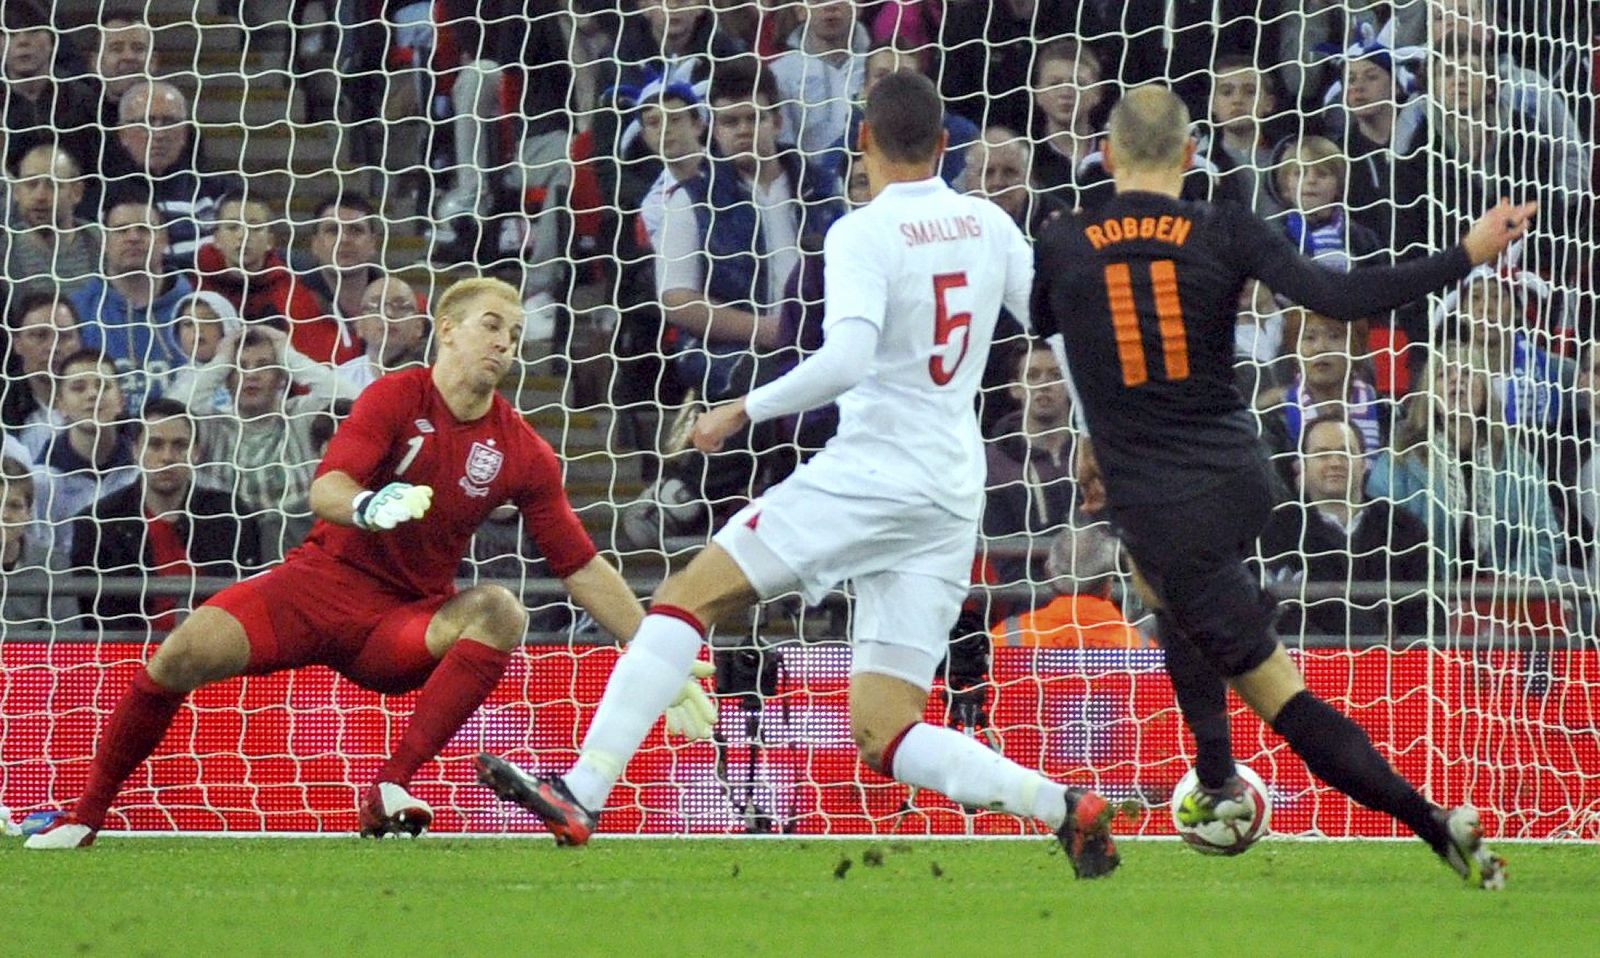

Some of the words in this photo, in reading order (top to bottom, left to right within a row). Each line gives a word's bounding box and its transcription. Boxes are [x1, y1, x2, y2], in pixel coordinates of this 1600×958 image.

[900, 215, 982, 246] SMALLING
[1085, 216, 1192, 250] ROBBEN
[928, 272, 971, 386] 5
[1105, 259, 1190, 387] 11
[396, 436, 424, 475] 1
